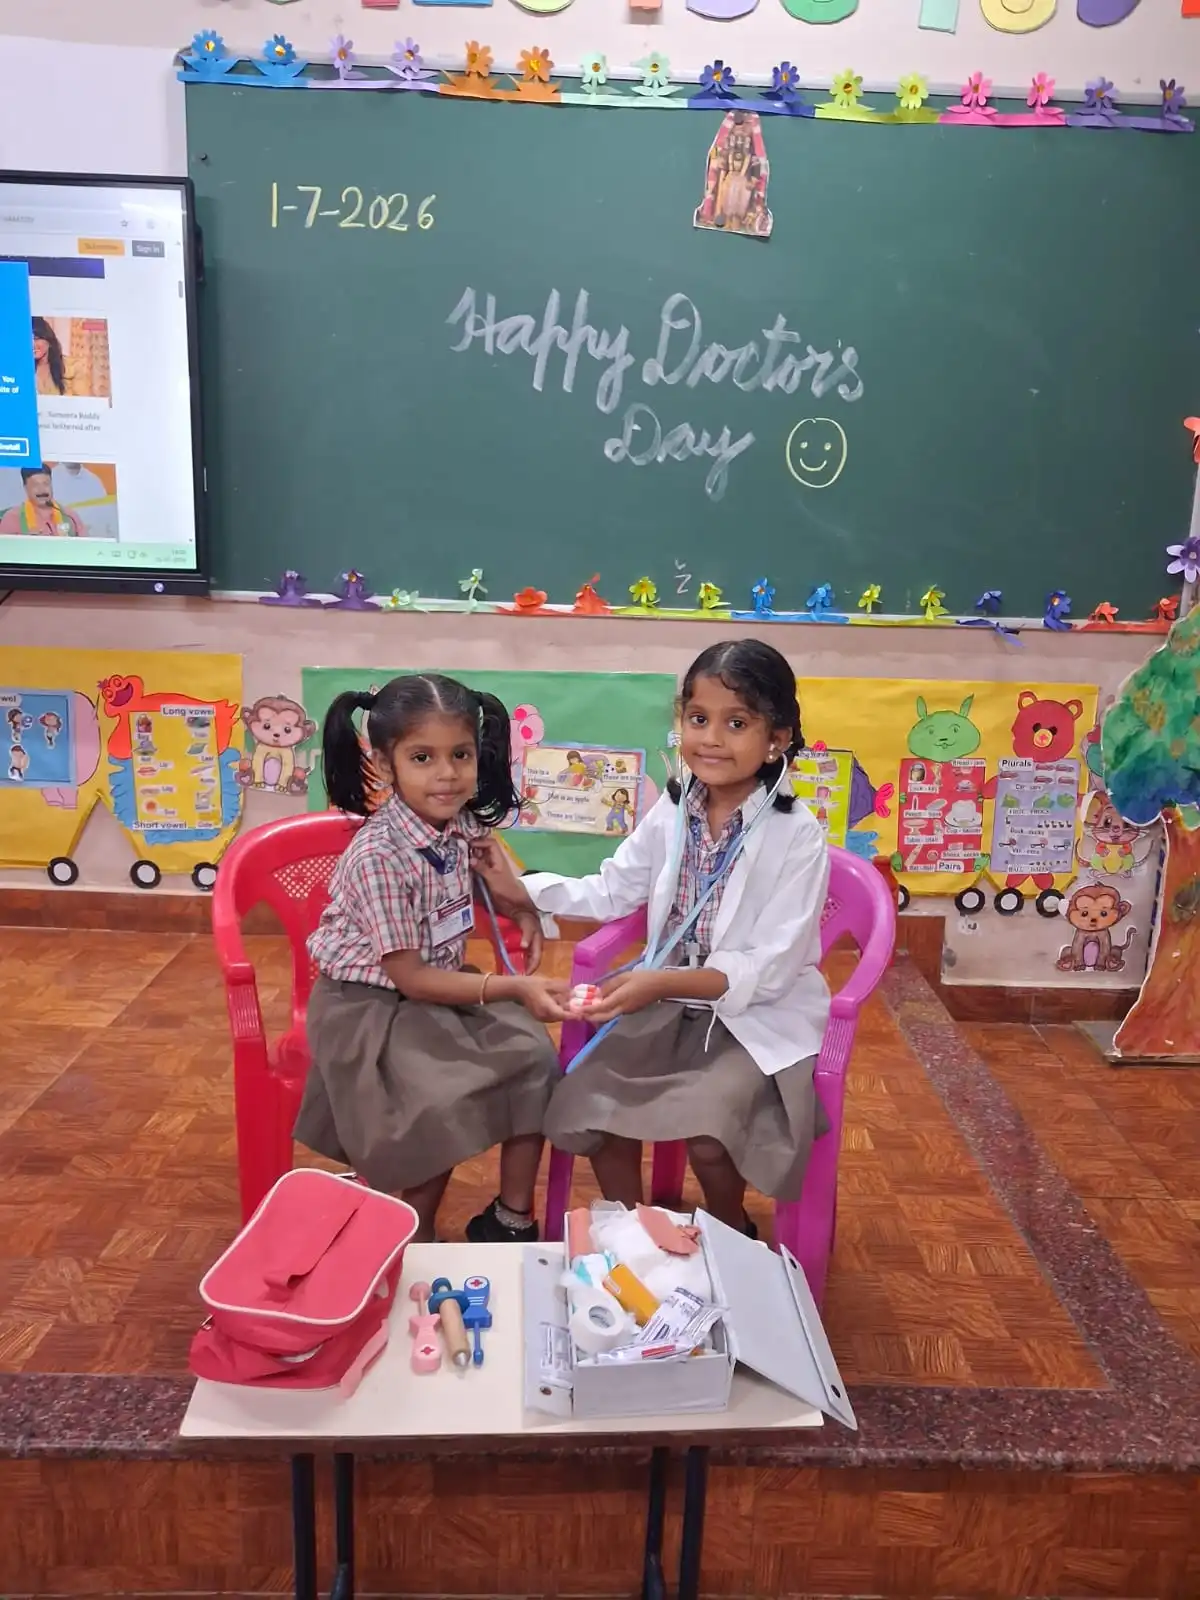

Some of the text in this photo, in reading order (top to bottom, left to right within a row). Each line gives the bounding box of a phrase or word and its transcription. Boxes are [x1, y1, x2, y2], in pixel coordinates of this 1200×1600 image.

[271, 182, 437, 231] 1-7-2026
[445, 286, 865, 414] Happy Doctor's
[603, 403, 756, 501] Day
[162, 707, 215, 716] Long vowel
[1001, 759, 1032, 768] Plurals
[133, 820, 187, 829] Short vowel
[938, 861, 962, 871] Pairs
